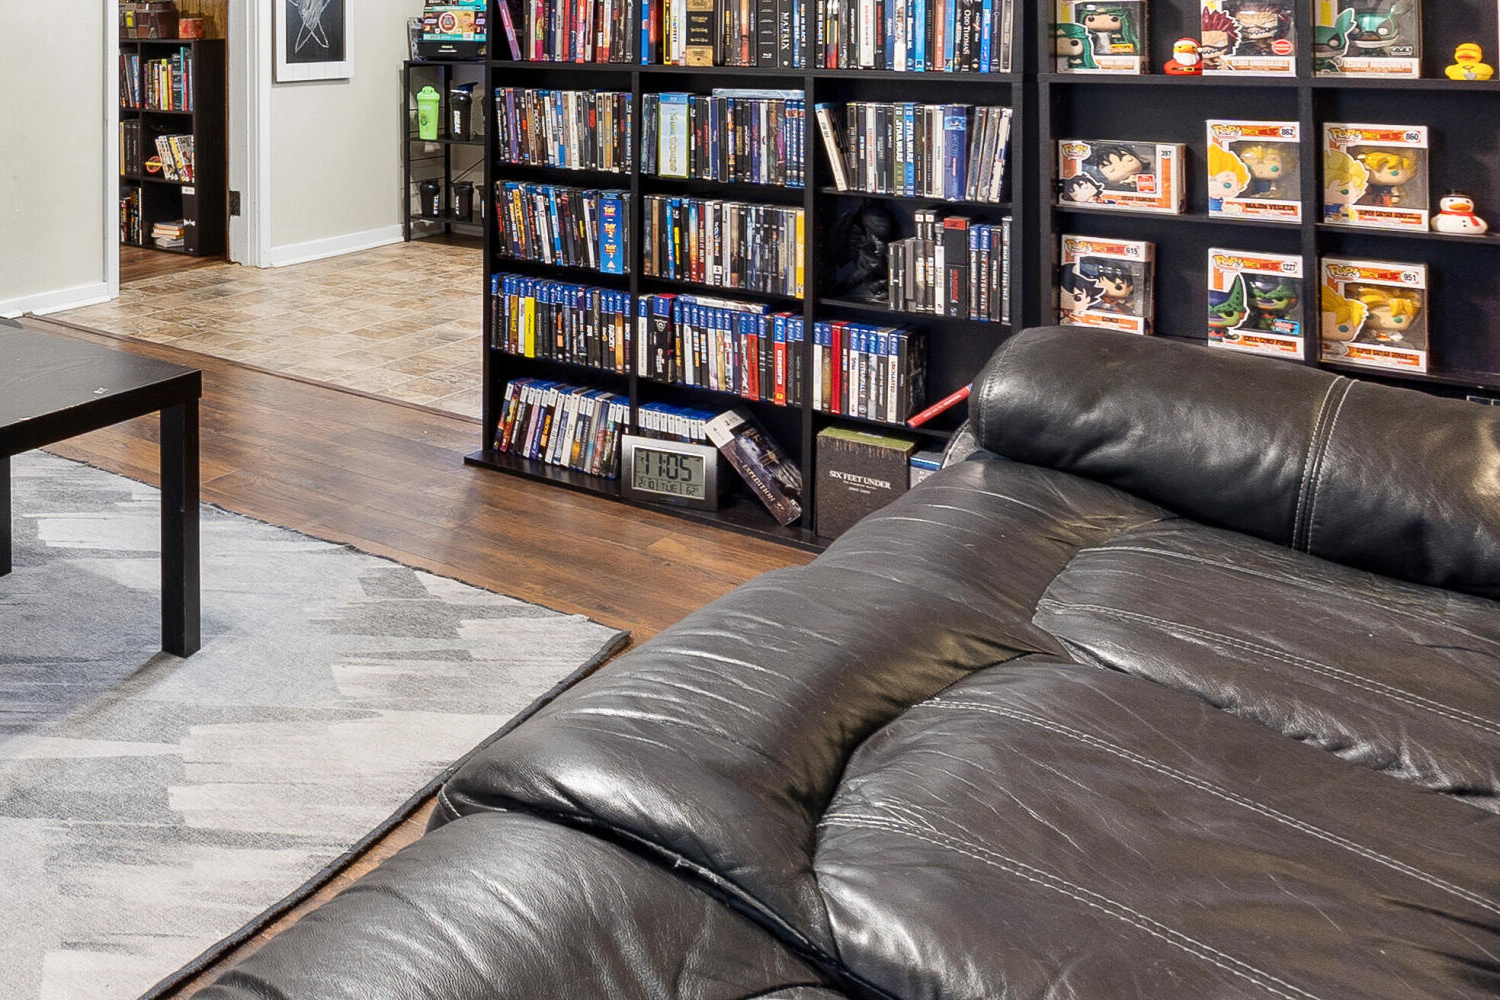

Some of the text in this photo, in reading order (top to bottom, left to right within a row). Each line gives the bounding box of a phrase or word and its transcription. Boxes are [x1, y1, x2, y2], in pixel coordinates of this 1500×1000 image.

[963, 9, 972, 55] ODD THOMAS
[1403, 272, 1417, 282] 951
[829, 470, 843, 480] SIX
[843, 472, 862, 483] FEET
[863, 475, 892, 490] UNDER
